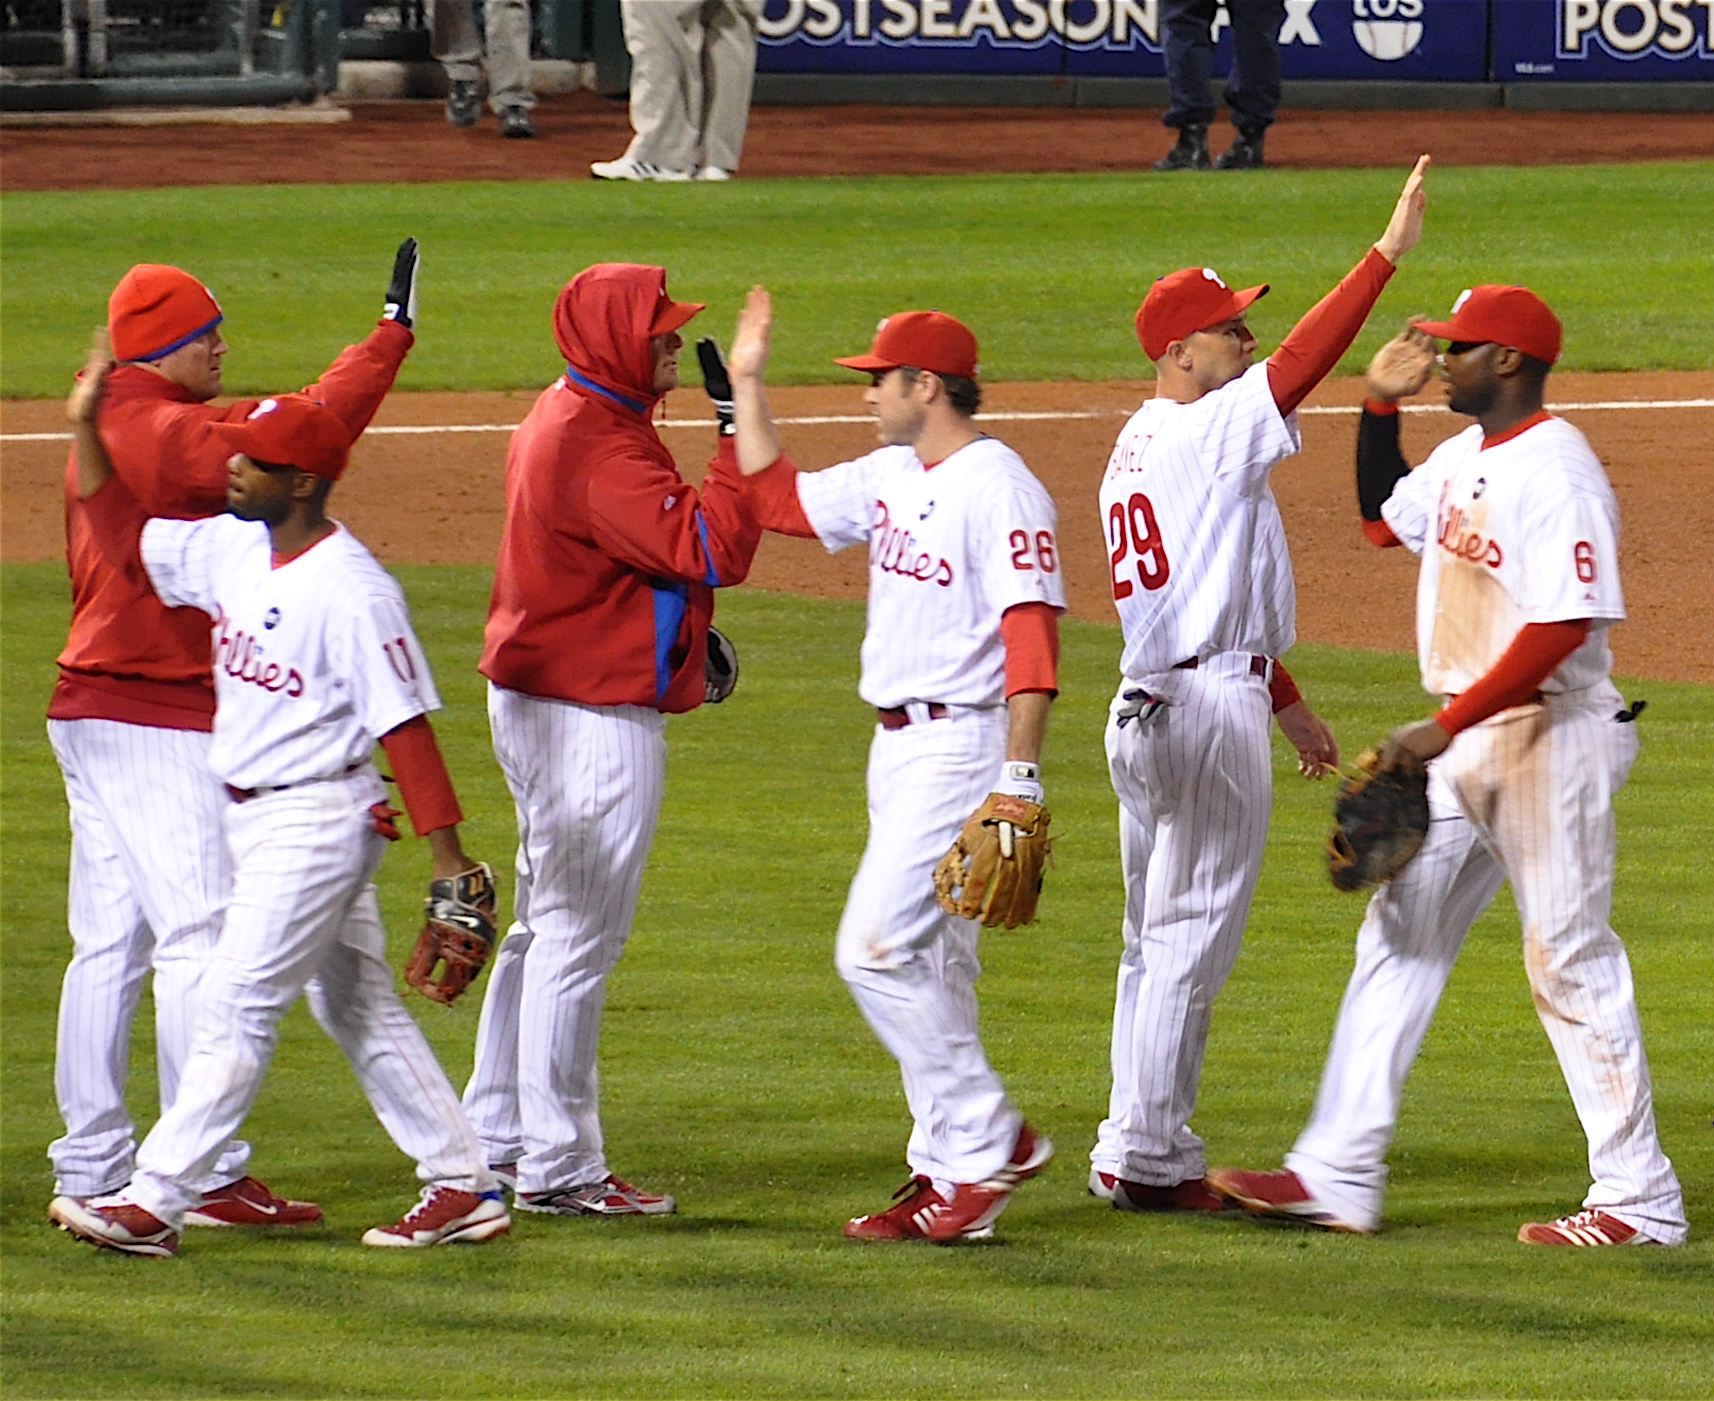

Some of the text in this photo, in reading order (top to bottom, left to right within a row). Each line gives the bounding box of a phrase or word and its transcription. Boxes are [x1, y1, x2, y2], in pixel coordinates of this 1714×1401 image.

[756, 0, 1160, 43] OSTSEASON
[1009, 529, 1056, 573] 26
[1109, 493, 1170, 600] 29
[1573, 540, 1597, 584] 6
